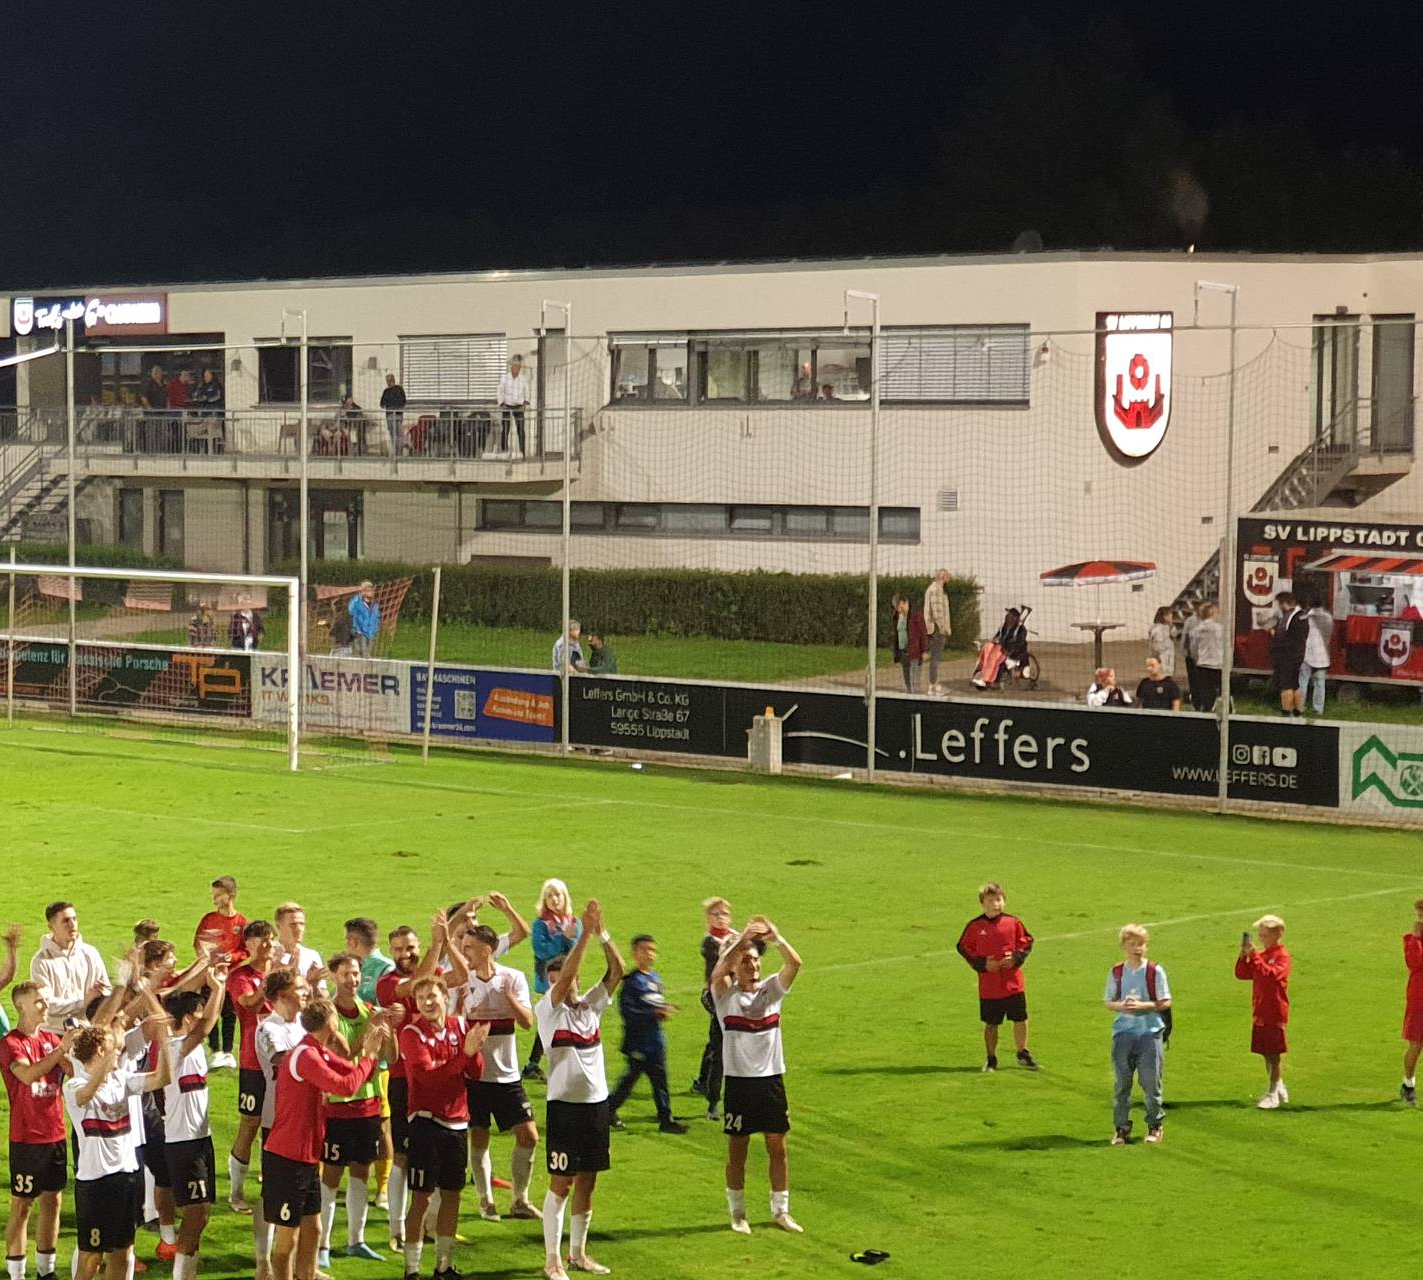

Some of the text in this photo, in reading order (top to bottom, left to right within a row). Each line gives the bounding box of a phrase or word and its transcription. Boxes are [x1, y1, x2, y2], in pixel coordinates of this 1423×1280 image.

[1263, 525, 1292, 540] SV
[1296, 526, 1410, 547] LIPPSTADT
[125, 655, 169, 671] Porsche
[582, 687, 690, 706] Leffers GmbH & Co. KG
[611, 706, 640, 723] Lange
[676, 709, 690, 723] 67
[611, 721, 690, 741] 59555 Lippstadt
[240, 1093, 255, 1112] 20
[724, 1112, 743, 1131] 24
[323, 1143, 340, 1162] 15
[549, 1152, 568, 1172] 30
[15, 1174, 34, 1193] 35
[410, 1167, 425, 1187] 11
[187, 1180, 208, 1199] 21
[280, 1202, 291, 1221] 6
[90, 1227, 100, 1246] 8
